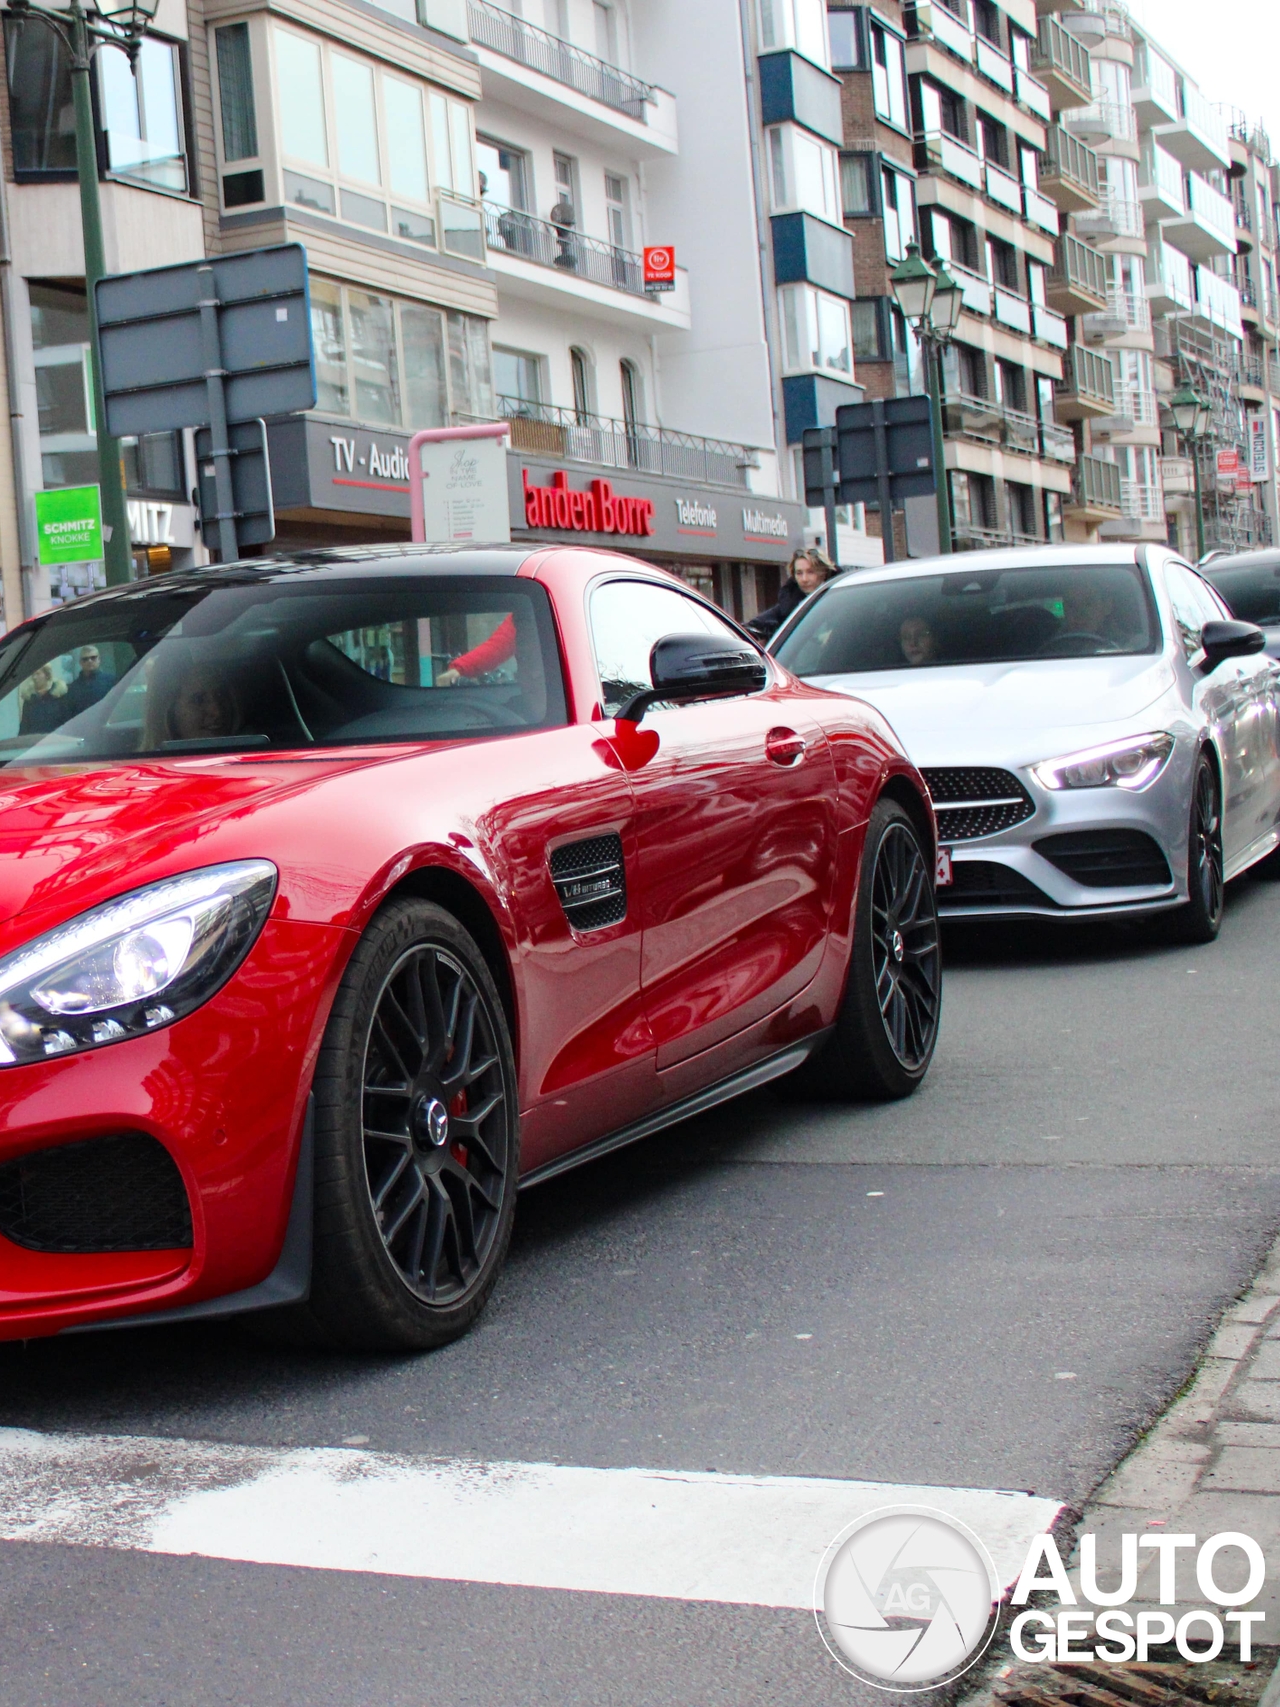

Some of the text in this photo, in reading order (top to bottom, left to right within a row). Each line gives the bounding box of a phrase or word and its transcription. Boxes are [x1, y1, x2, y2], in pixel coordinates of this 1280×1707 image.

[330, 436, 355, 473] TV
[460, 480, 482, 488] LOVE
[126, 500, 176, 544] MITZ
[597, 479, 656, 536] Borre
[675, 498, 717, 528] Telefonie
[44, 519, 95, 535] SCHMITZ
[742, 508, 788, 537] Multimedia
[50, 532, 90, 545] KNOKKE
